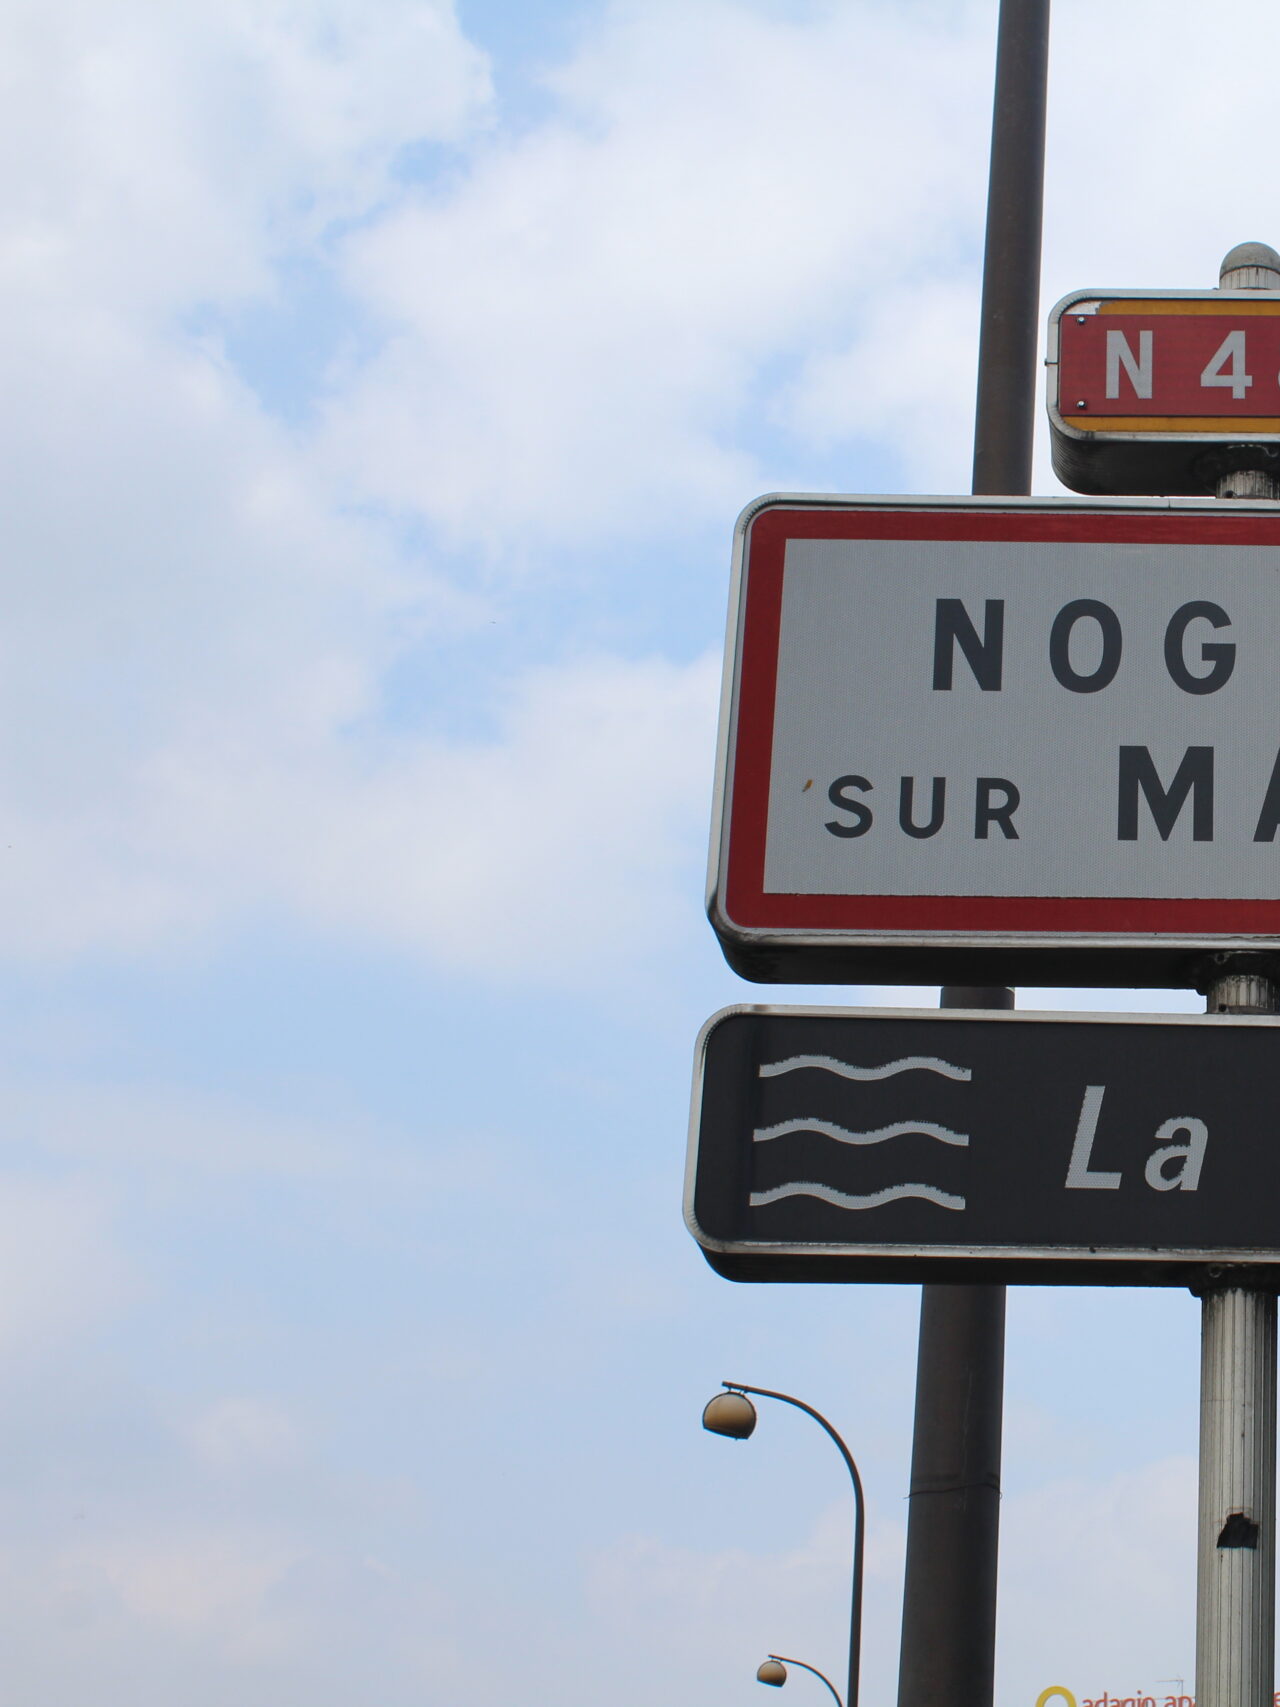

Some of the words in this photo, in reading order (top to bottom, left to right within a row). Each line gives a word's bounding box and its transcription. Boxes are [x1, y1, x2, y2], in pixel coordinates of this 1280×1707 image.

[1105, 329, 1154, 400] N
[823, 774, 1021, 840] SUR
[1064, 1085, 1209, 1192] La
